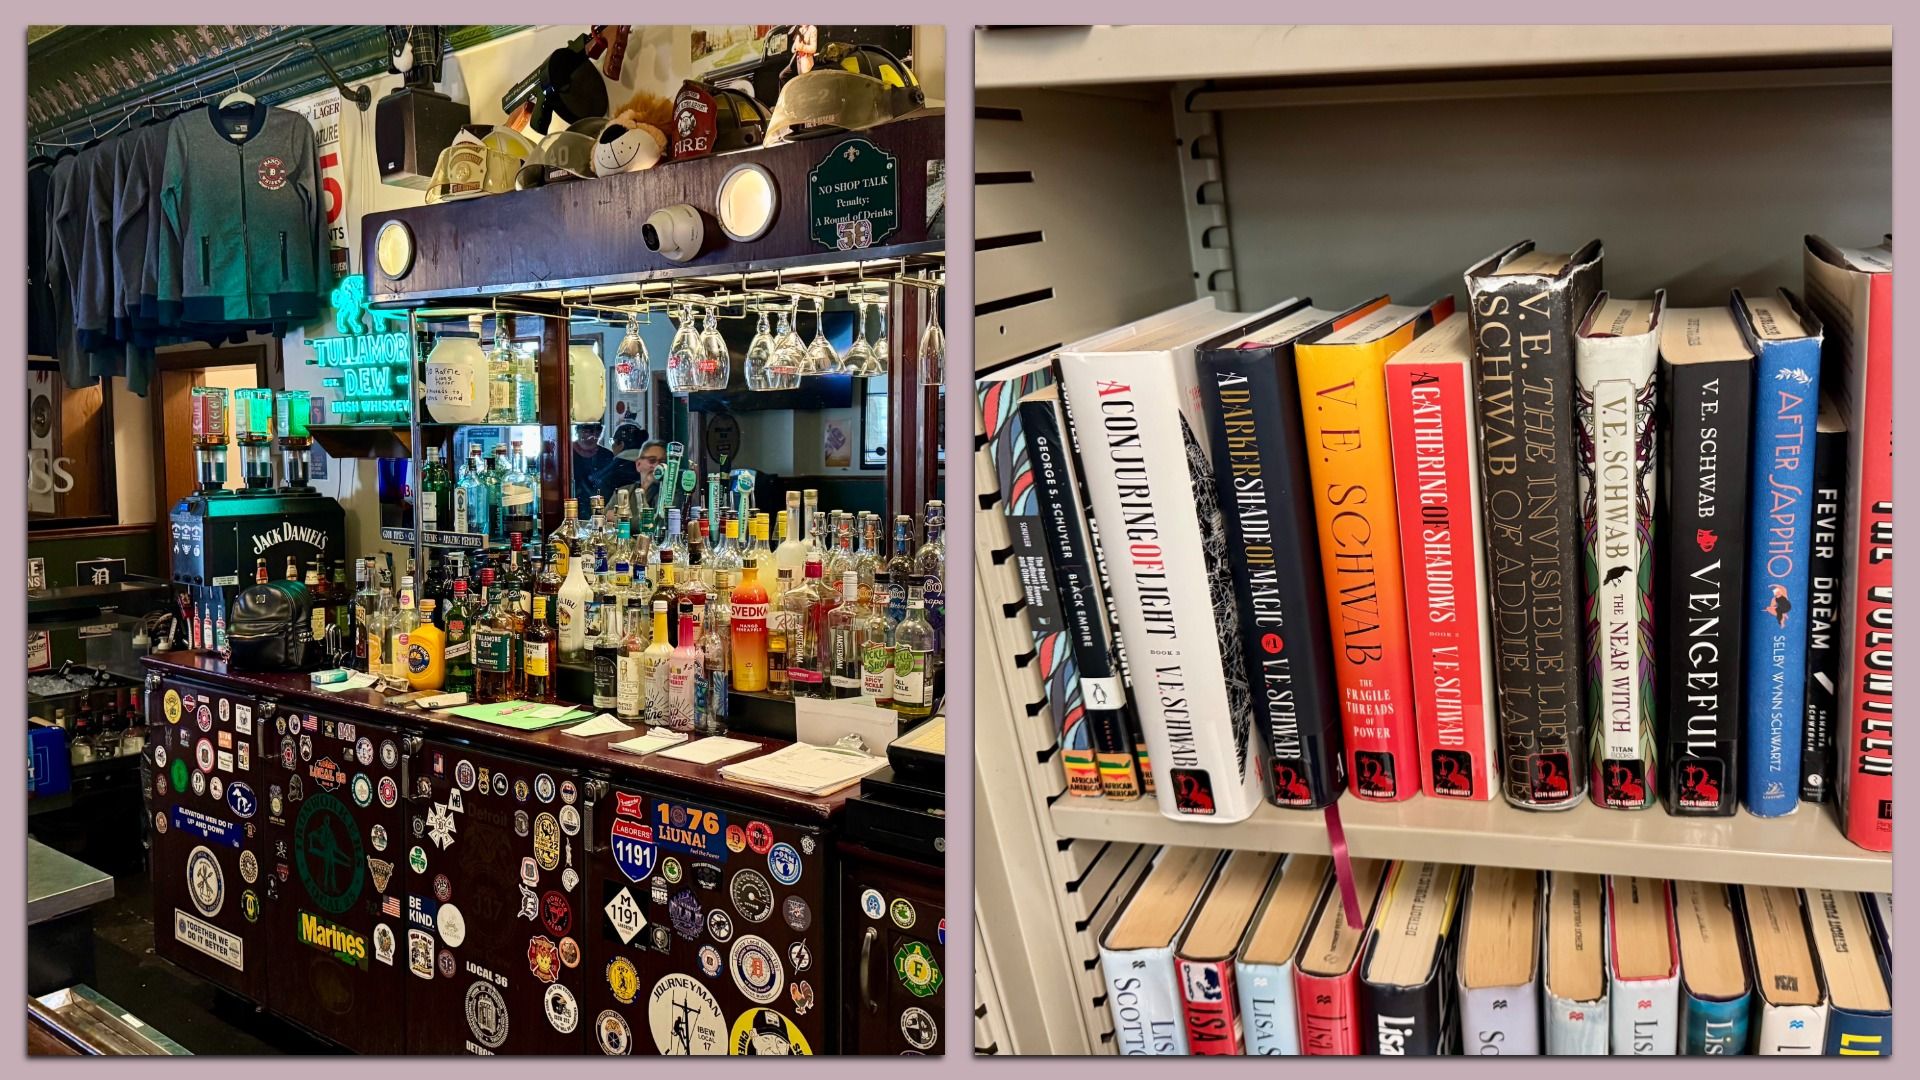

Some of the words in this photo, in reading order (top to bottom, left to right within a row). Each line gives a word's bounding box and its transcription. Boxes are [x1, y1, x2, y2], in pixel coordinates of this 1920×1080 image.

[313, 102, 341, 121] LAGER
[674, 136, 708, 158] FIRE
[818, 183, 833, 196] NO
[834, 179, 861, 194] SHOP
[862, 175, 889, 188] TALK
[836, 195, 871, 209] Penalty:
[815, 217, 823, 228] A
[823, 213, 851, 227] Round
[852, 210, 864, 222] of
[863, 206, 894, 221] Drinks
[836, 219, 873, 251] 58
[313, 333, 410, 368] TULLAMOR
[434, 367, 461, 377] Raffle
[1216, 372, 1249, 388] A
[1410, 372, 1440, 387] A
[443, 394, 464, 402] Fund
[1096, 380, 1132, 398] A
[1476, 295, 1518, 476] SCHWAB
[332, 400, 359, 414] IRISH
[1521, 376, 1558, 465] THE
[1774, 389, 1804, 471] AFTER
[1411, 386, 1449, 505] GATHERING
[1036, 435, 1057, 486] GEORGE
[1101, 400, 1159, 541] CONJURING
[1698, 427, 1718, 518] SCHWAB
[1049, 488, 1059, 499] S.
[1602, 449, 1630, 559] SCHWAB
[1233, 477, 1273, 546] SHADE
[1421, 505, 1451, 530] OF
[1490, 489, 1524, 547] OF
[1814, 488, 1838, 560] FEVER
[252, 526, 283, 555] JACK
[282, 520, 329, 550] DANIEL'S
[1019, 521, 1032, 548] SCHUYLER
[1052, 502, 1073, 559] SCHUYLER
[1766, 474, 1804, 578] SAPPHO
[1129, 544, 1166, 572] OF
[1244, 545, 1277, 568] OF
[1021, 568, 1030, 584] Other
[1028, 556, 1039, 584] Bradhurst
[1038, 568, 1047, 584] Beast
[1327, 483, 1383, 666] SCHWAB
[1422, 528, 1456, 624] SHADOWS
[1526, 473, 1566, 676] INVISIBLE
[1025, 585, 1035, 605] Stories
[1033, 585, 1044, 607] Avenue
[1136, 571, 1177, 640] LIGHT
[1247, 567, 1284, 627] MAGIC
[1613, 593, 1624, 616] THE
[731, 603, 768, 619] SVEDKA
[1068, 573, 1082, 607] BLACK
[1077, 610, 1093, 648] EMPIRE
[1494, 548, 1531, 673] ADDIE
[1810, 576, 1834, 650] DREAM
[795, 624, 804, 663] AMSTERDAM
[1150, 649, 1173, 657] BOOK
[1609, 620, 1629, 671] NEAR
[1772, 635, 1786, 670] SELBY
[1686, 558, 1721, 759] VENGEFUL
[1346, 688, 1391, 701] FRAGILE
[1359, 679, 1373, 687] THE
[1770, 672, 1785, 711] WYNN
[1346, 701, 1395, 715] THREADS
[1433, 675, 1465, 746] SCHWAB
[1611, 676, 1632, 733] WITCH
[1160, 695, 1199, 767] SCHWAB
[1266, 688, 1301, 760] SCHWAB
[1353, 726, 1391, 739] POWER
[1365, 717, 1375, 726] OF
[1807, 704, 1816, 752] SCHWEBLIN
[1818, 709, 1827, 748] SAMANTA
[1768, 712, 1784, 773] SCHWARTZ
[309, 764, 335, 782] LOCAL
[1071, 775, 1100, 785] AFRICAN
[1104, 782, 1133, 790] AFRICAN
[1622, 798, 1645, 806] FANTASY
[1695, 799, 1719, 807] FANTASY
[179, 806, 205, 821] ELEVATOR
[205, 815, 217, 825] MEN
[218, 818, 227, 828] DO
[227, 822, 234, 830] IT
[187, 817, 195, 826] UP
[195, 820, 207, 830] AND
[207, 824, 225, 836] DOWN
[658, 825, 707, 849] LiUNA!
[615, 840, 651, 869] 1191
[773, 849, 797, 865] POAM
[408, 895, 422, 911] BE
[620, 894, 631, 907] M
[408, 909, 435, 929] KIND.
[611, 903, 639, 928] 1191
[1405, 905, 1420, 937] DETROIT
[187, 920, 217, 942] TOGETHER
[218, 936, 229, 948] WE
[187, 931, 197, 942] DO
[197, 934, 204, 945] IT
[204, 938, 229, 957] BETTER
[302, 912, 366, 959] Marines
[913, 944, 923, 956] A
[466, 960, 494, 983] LOCAL
[494, 974, 509, 988] 36
[913, 960, 924, 978] F
[930, 968, 938, 984] F
[653, 977, 721, 1018] JOURNEYMAN
[698, 1026, 716, 1037] IBEW
[1252, 997, 1279, 1042] LISA
[698, 1034, 716, 1044] LOCAL
[702, 1041, 712, 1052] 17
